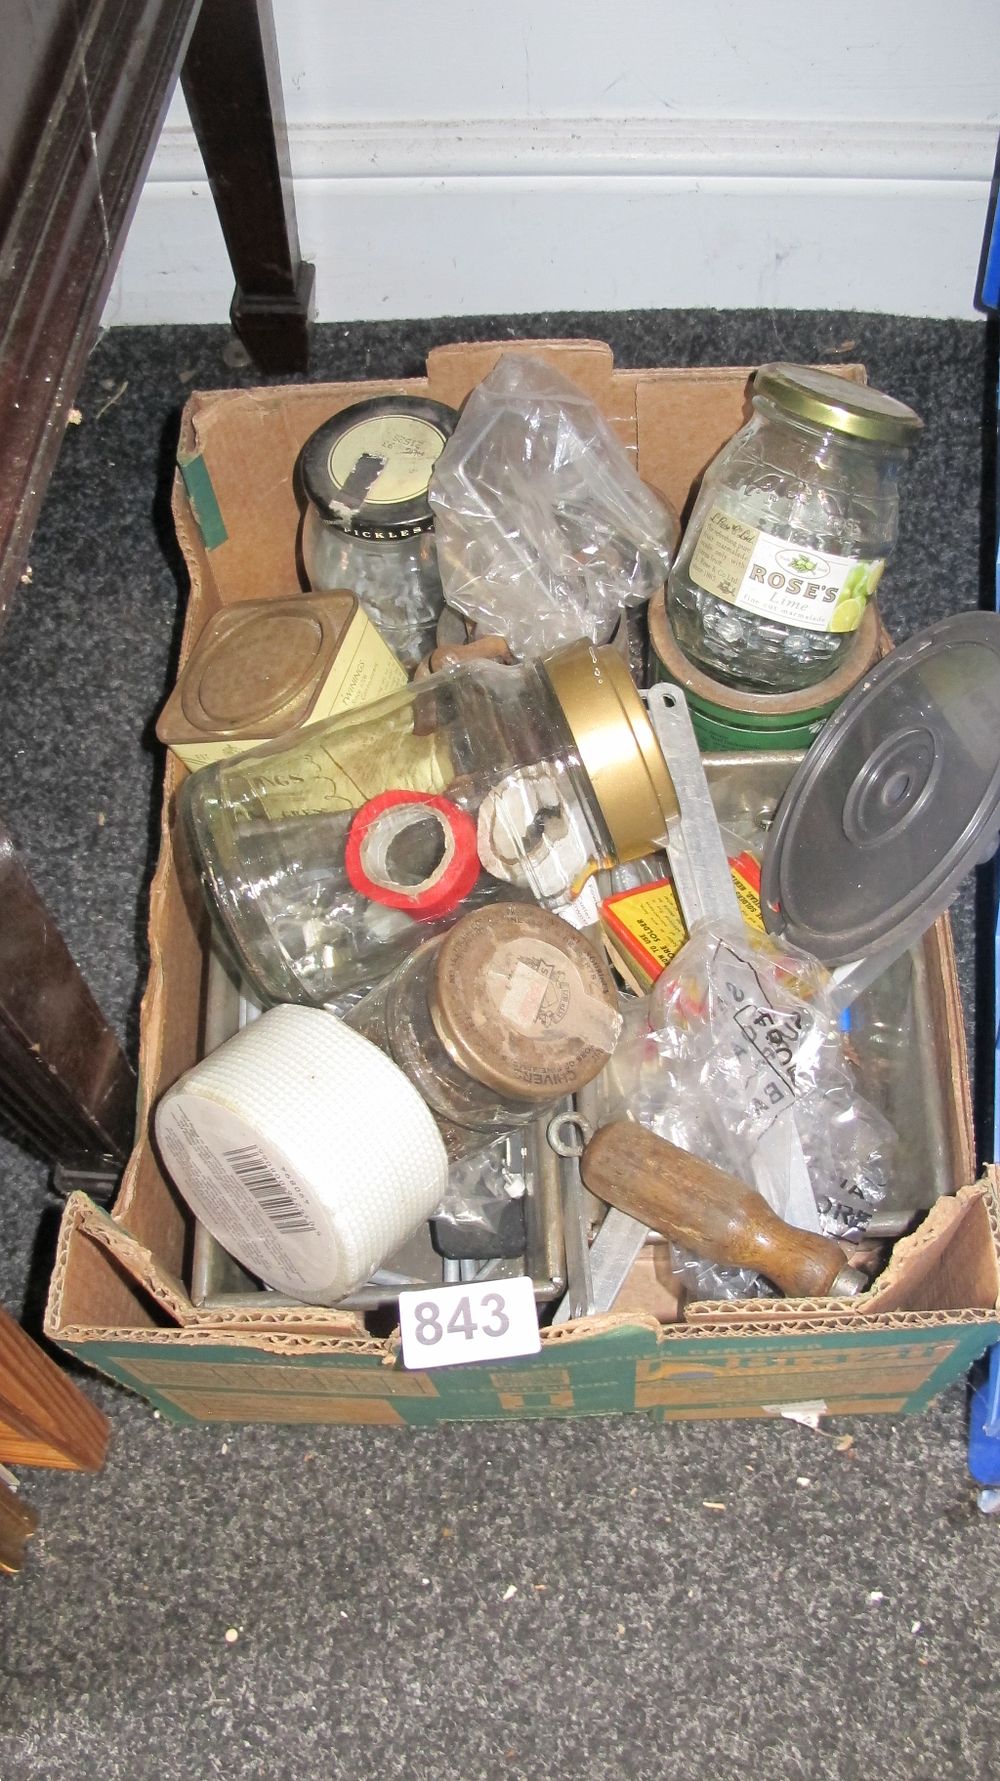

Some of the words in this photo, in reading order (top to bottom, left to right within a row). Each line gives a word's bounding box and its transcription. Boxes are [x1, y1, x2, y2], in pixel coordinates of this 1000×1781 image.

[344, 526, 422, 539] PICKLES
[748, 563, 840, 604] ROSE'S
[769, 591, 809, 612] Lime
[636, 919, 661, 943] SOLDER
[639, 934, 651, 945] USE
[649, 944, 658, 953] TO
[413, 1292, 511, 1347] 843
